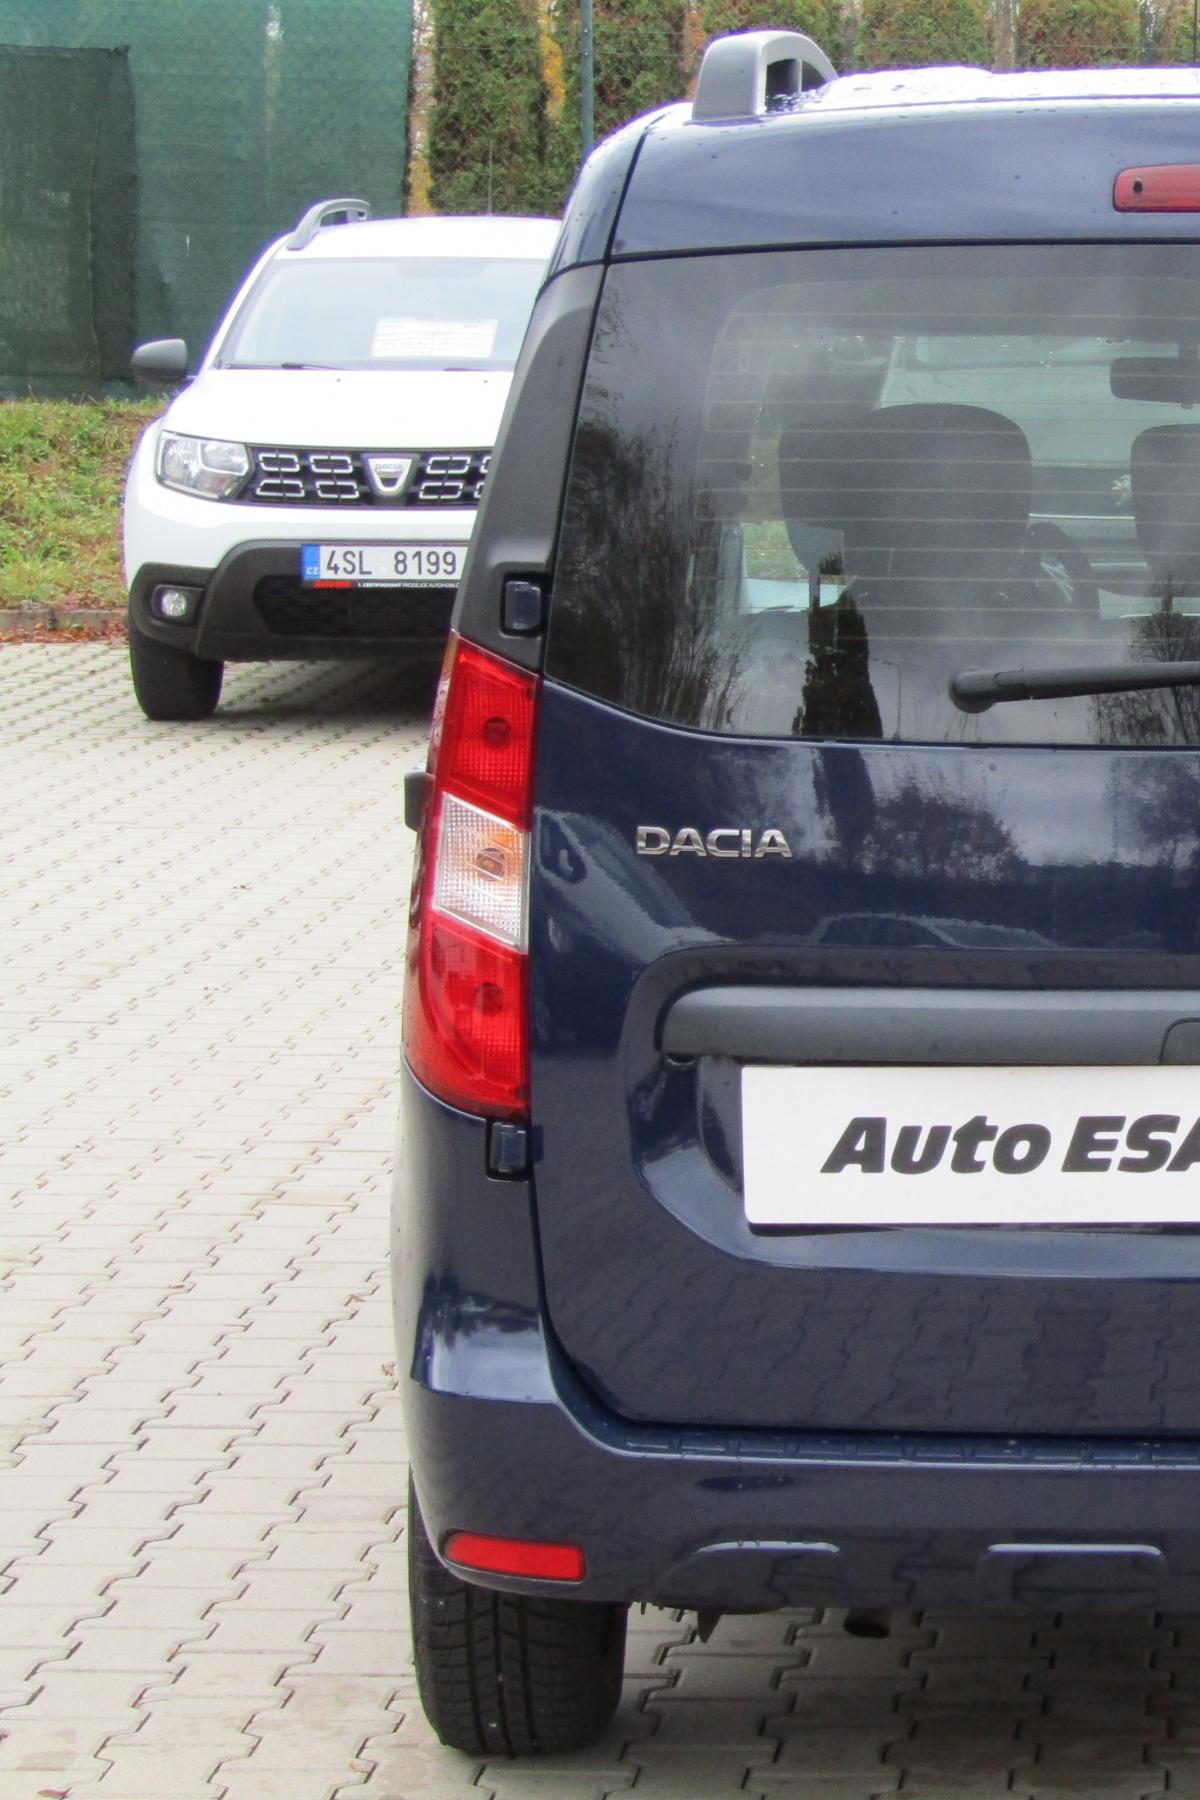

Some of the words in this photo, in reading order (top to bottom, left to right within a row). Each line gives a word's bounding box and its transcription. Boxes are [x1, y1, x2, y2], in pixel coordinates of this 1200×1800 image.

[326, 550, 373, 576] 4SL
[394, 550, 457, 576] 8199
[636, 826, 793, 858] DACIA
[819, 1115, 1052, 1175] Auto
